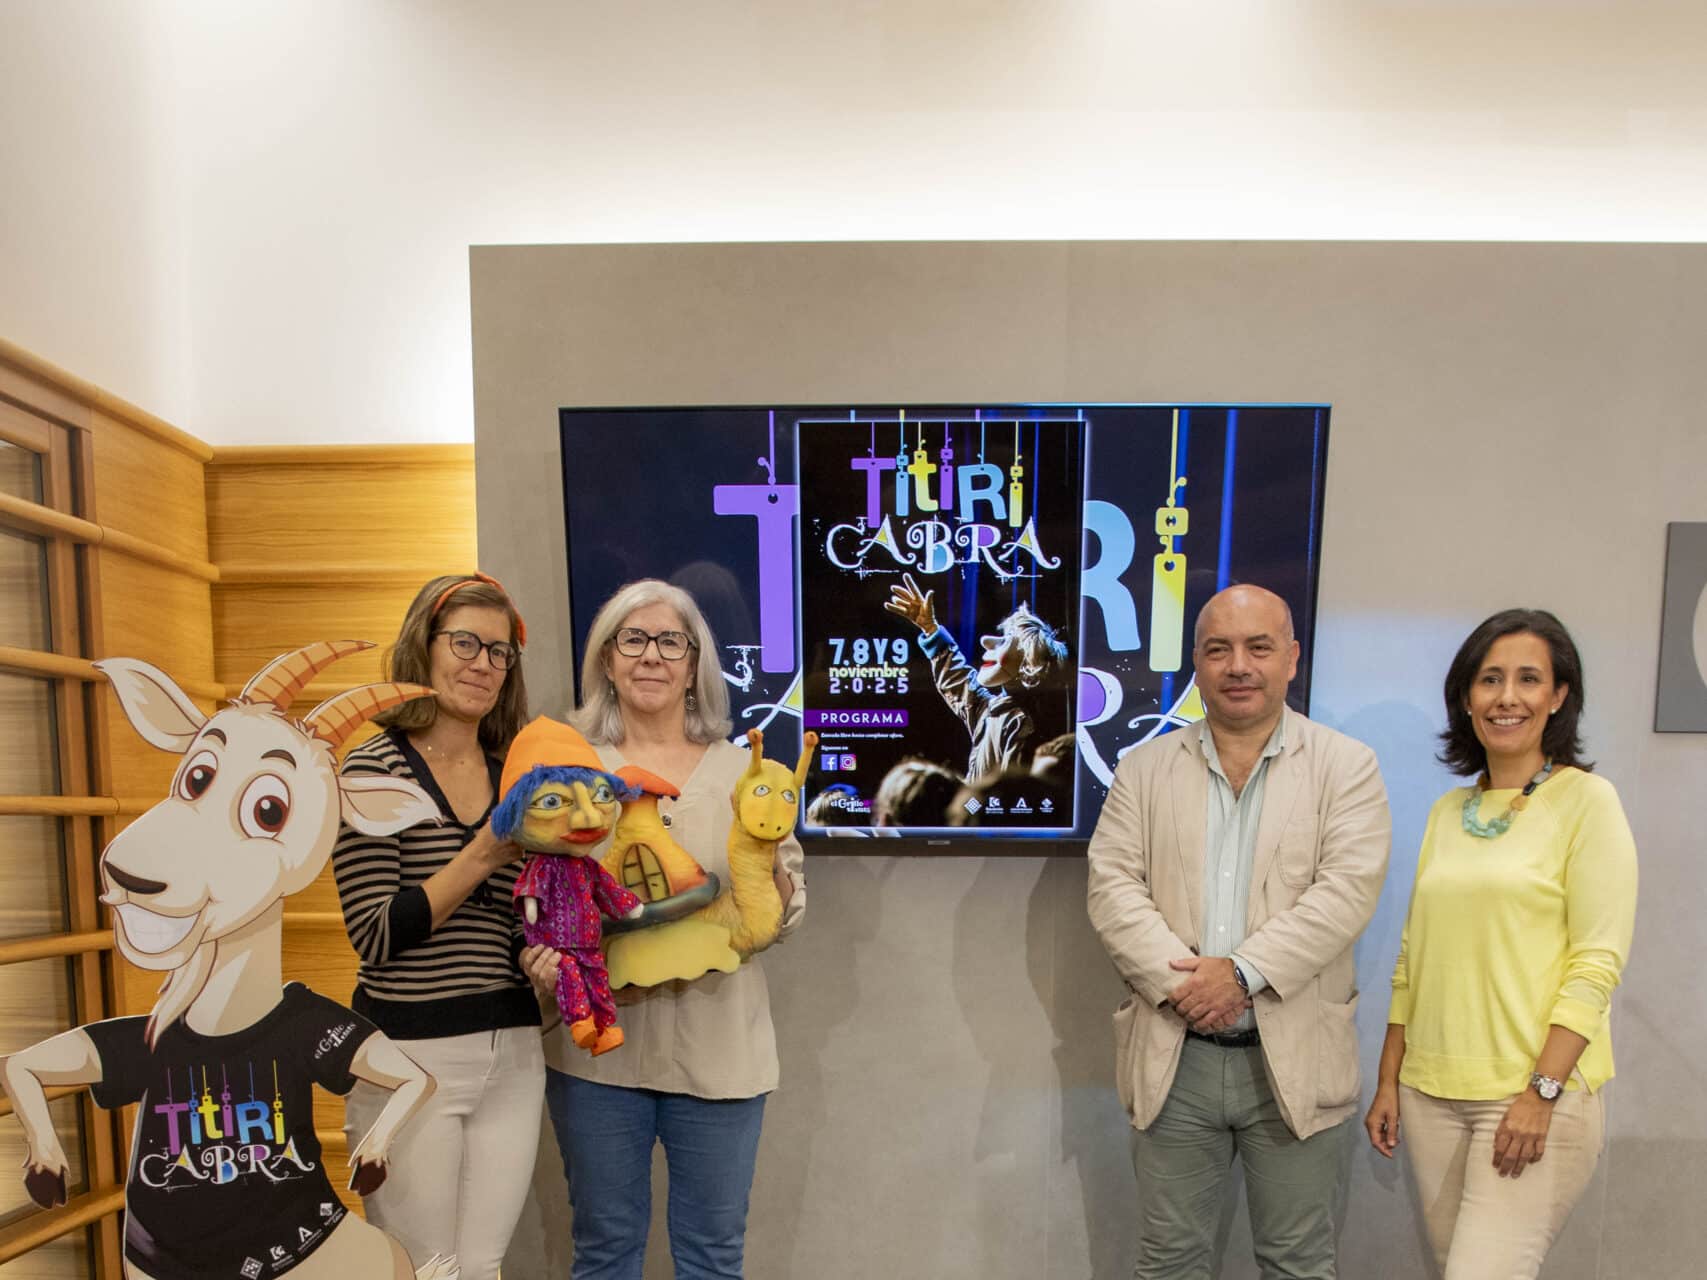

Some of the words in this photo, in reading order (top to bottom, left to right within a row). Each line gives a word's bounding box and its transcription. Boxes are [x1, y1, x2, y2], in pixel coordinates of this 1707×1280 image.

[826, 514, 1061, 578] CABRA
[828, 661, 909, 678] noviembre
[820, 712, 904, 724] PROGRAMA
[139, 1136, 315, 1188] CABRA
